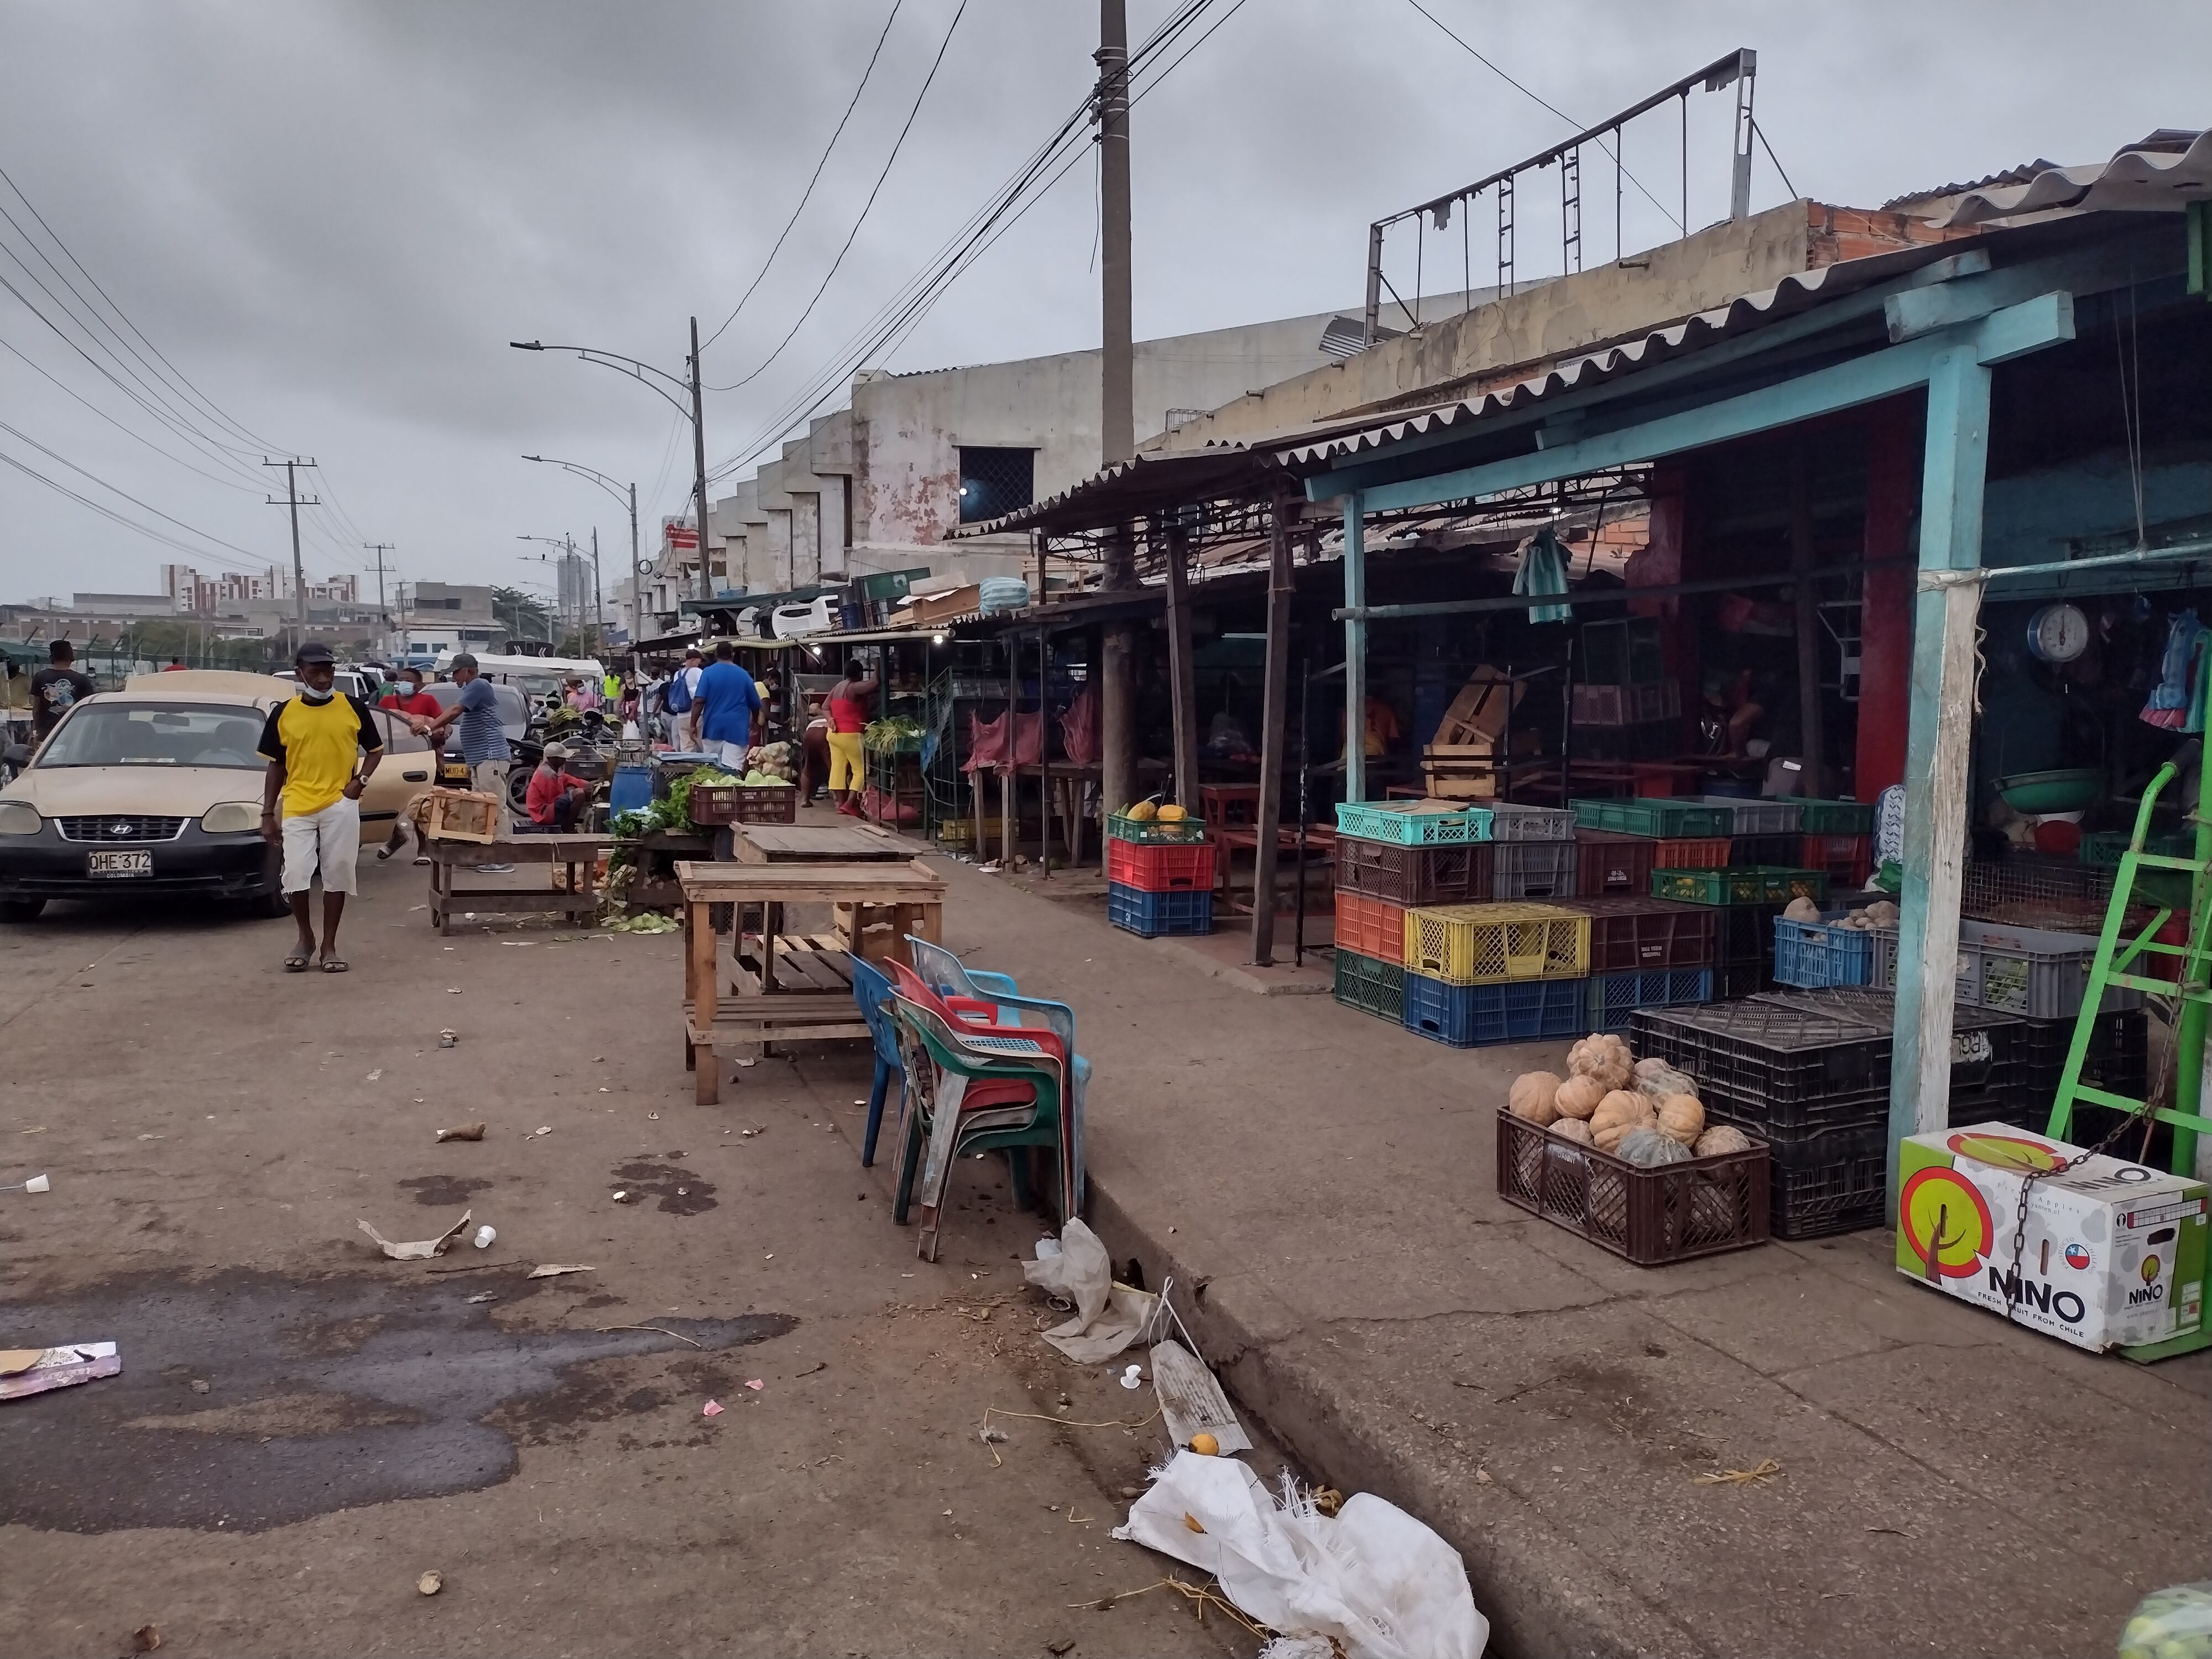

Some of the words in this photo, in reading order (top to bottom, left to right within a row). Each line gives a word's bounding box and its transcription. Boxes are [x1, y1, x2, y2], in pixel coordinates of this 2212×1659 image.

[122, 853, 151, 868] 372
[2059, 1167, 2151, 1190] NINO
[2038, 1196, 2079, 1214] Apples
[2058, 1237, 2075, 1270] PRODUCTO
[2085, 1243, 2098, 1275] CHILENO
[1989, 1266, 2085, 1324] NINO
[2129, 1284, 2163, 1305] NINO
[1978, 1291, 2002, 1306] FRESH
[2011, 1305, 2028, 1317] RUIT
[2032, 1313, 2055, 1327] FROM
[2059, 1324, 2084, 1338] CHILE
